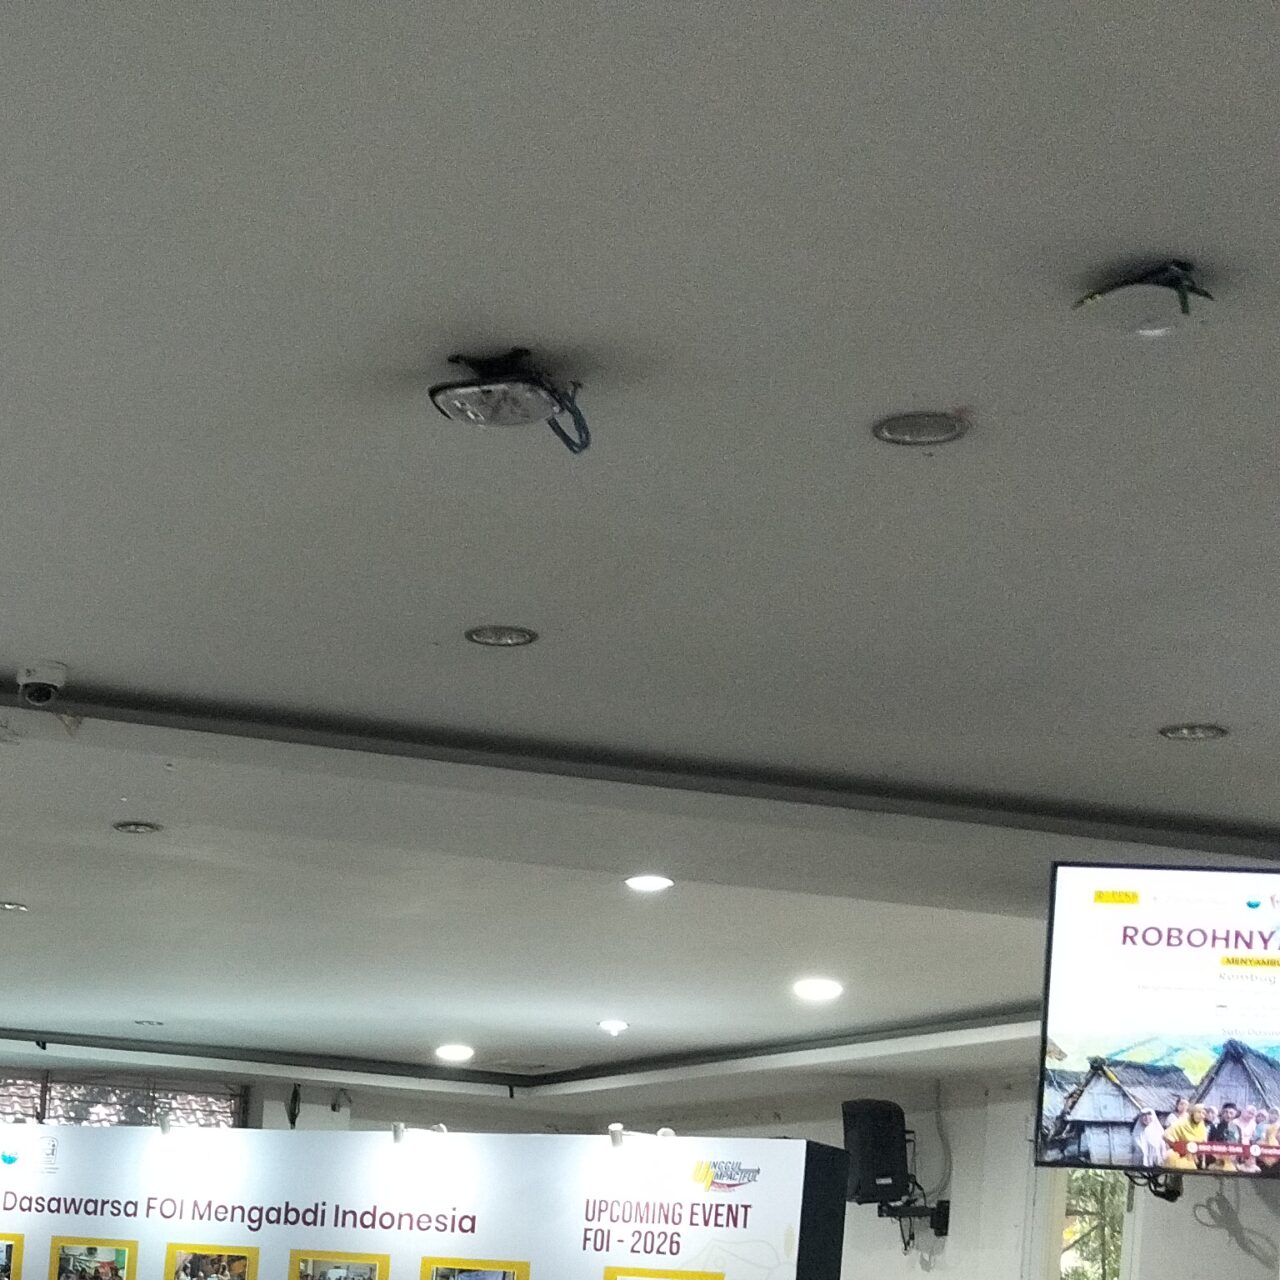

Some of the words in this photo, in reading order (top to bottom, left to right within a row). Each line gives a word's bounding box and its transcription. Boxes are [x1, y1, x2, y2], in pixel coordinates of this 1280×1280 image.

[1122, 925, 1280, 951] ROBOHNY
[3, 1190, 138, 1218] Dasawarsa
[146, 1197, 184, 1220] FOI
[192, 1199, 327, 1232] Mengabdi
[333, 1203, 477, 1234] Indonesia
[585, 1198, 683, 1226] UPCOMING
[689, 1202, 752, 1229] EVENT
[582, 1227, 611, 1252] FOI
[630, 1230, 682, 1256] 2026
